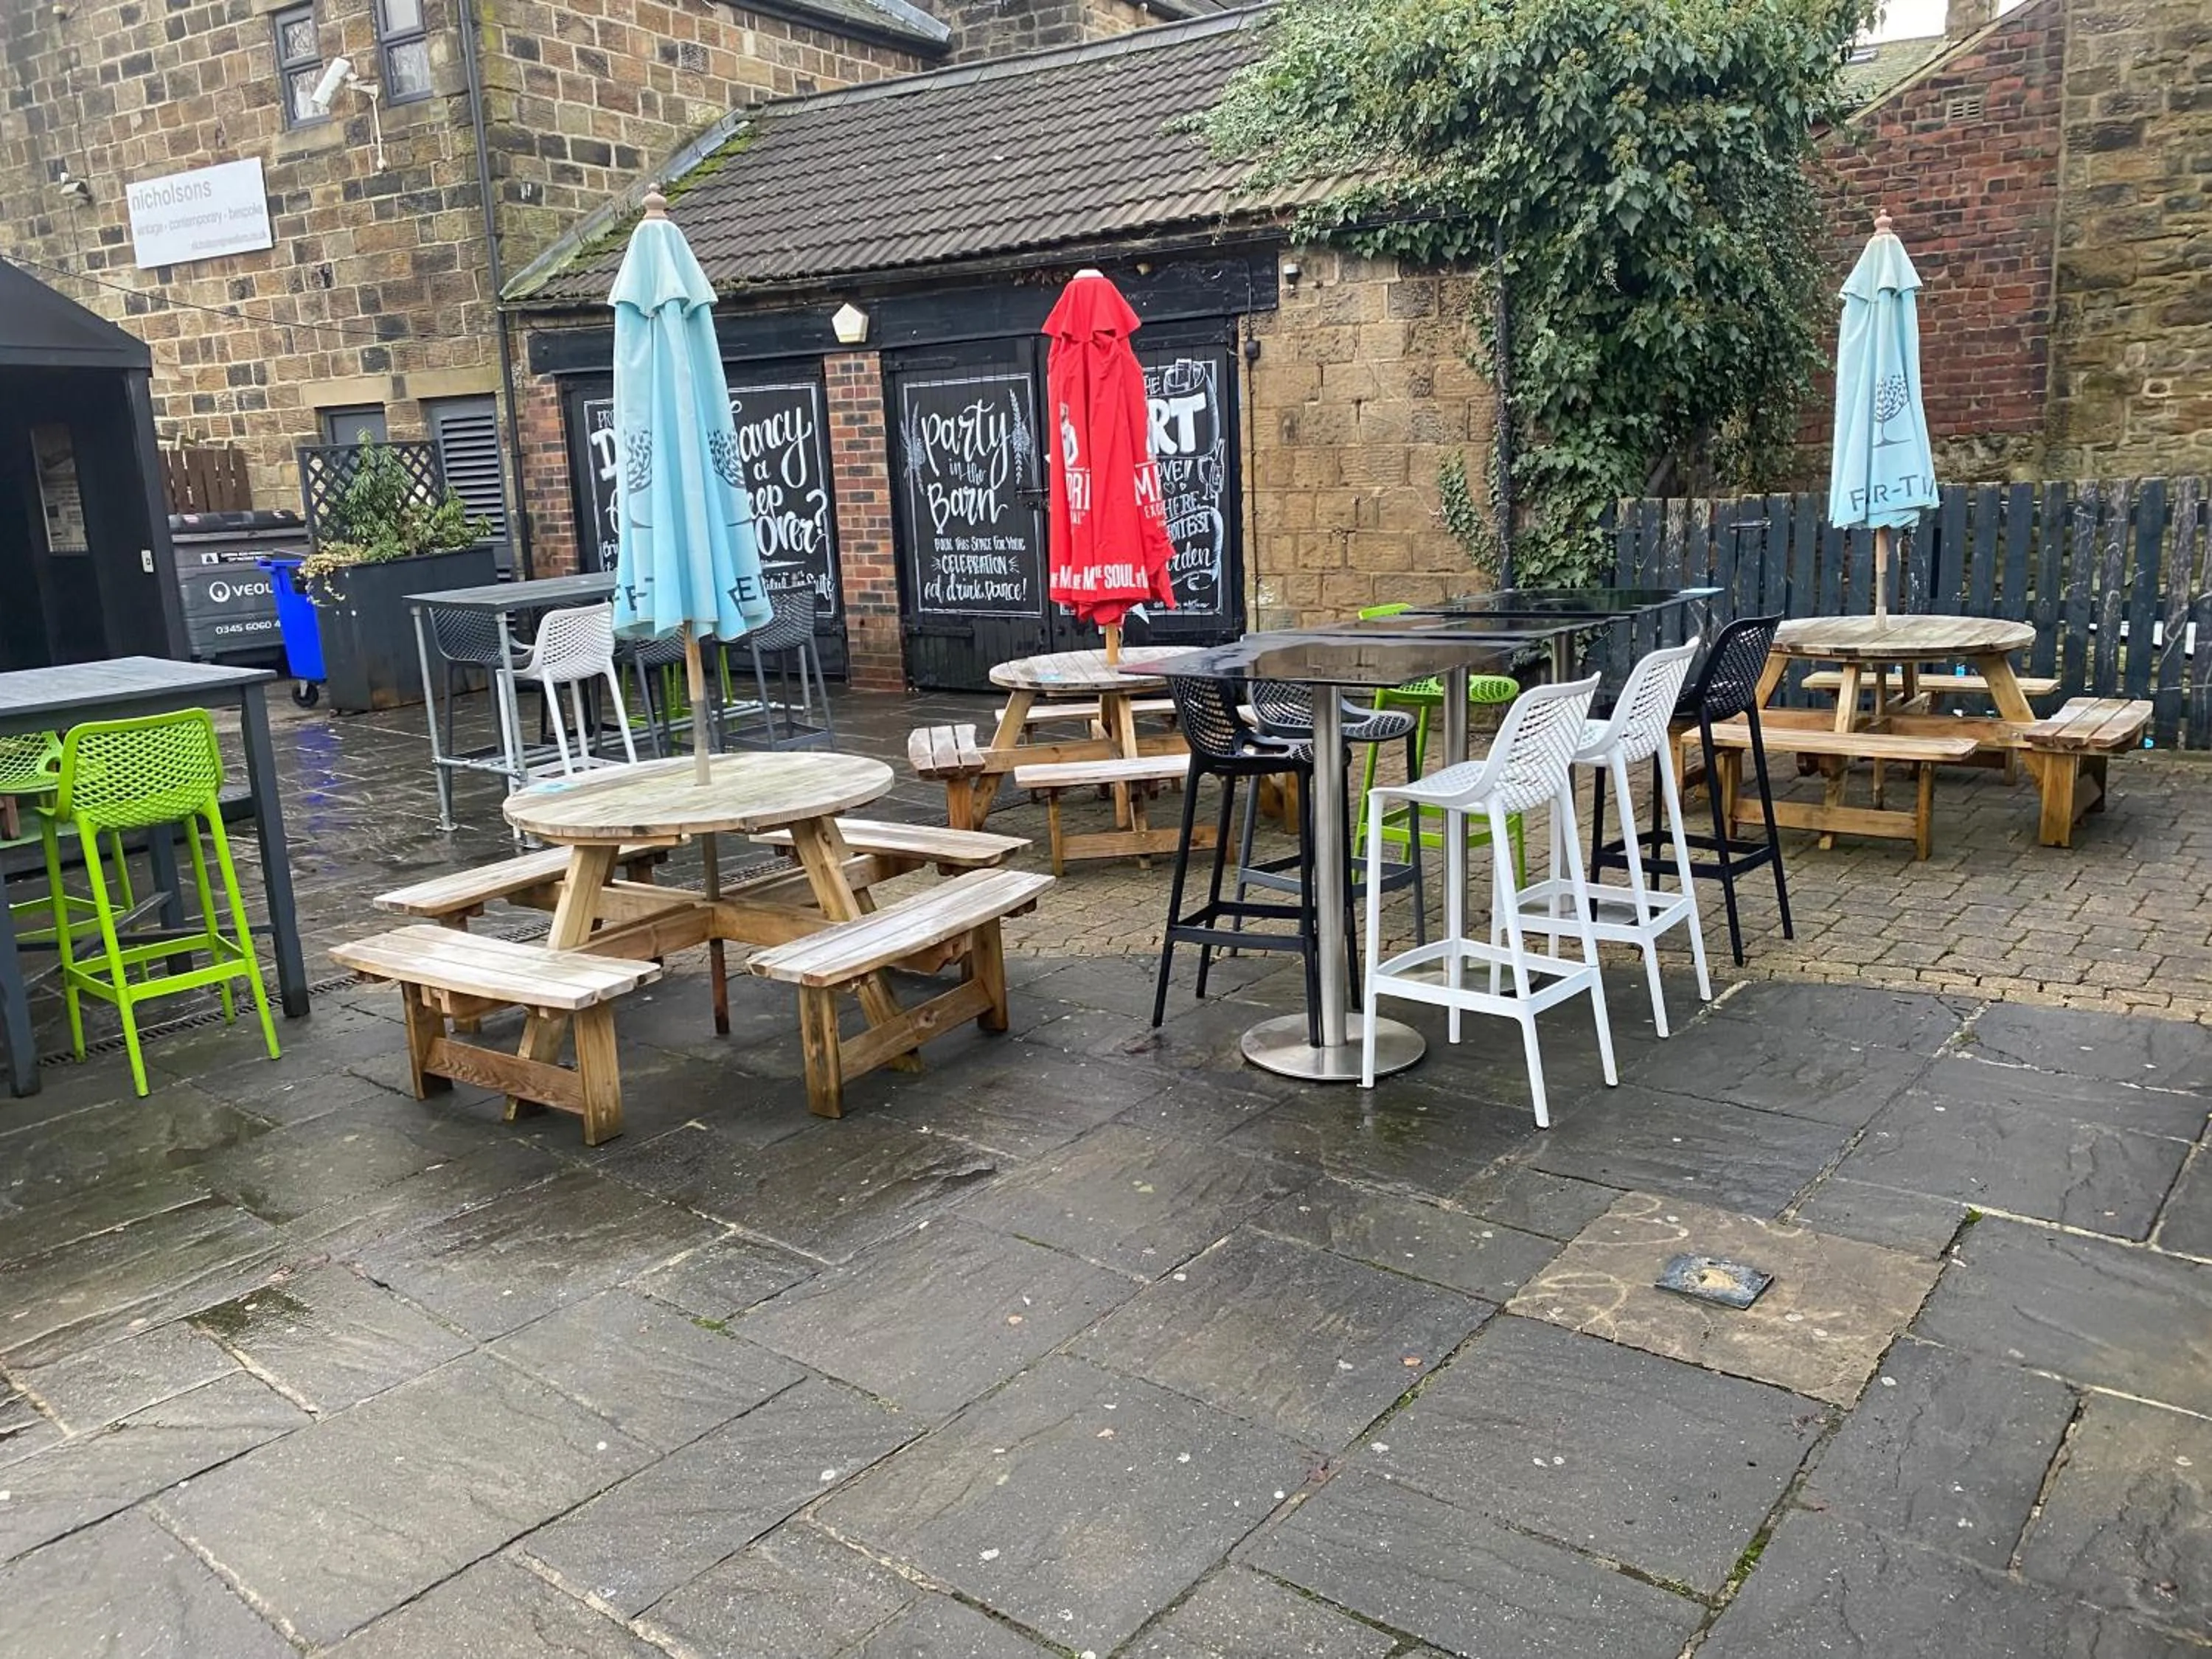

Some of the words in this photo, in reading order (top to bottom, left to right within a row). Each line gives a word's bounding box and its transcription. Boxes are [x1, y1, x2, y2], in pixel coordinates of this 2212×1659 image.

[132, 181, 212, 211] nicholsons
[170, 210, 221, 230] contemporary
[227, 202, 263, 220] bespoke
[739, 406, 812, 489] ancy
[753, 459, 771, 481] a
[948, 458, 963, 481] in
[747, 484, 784, 519] eep
[928, 482, 1008, 535] Barn
[941, 554, 1008, 575] CELEBRATION
[1104, 563, 1135, 588] SOUL
[232, 582, 274, 596] VEOL
[215, 624, 243, 635] 0345
[246, 621, 272, 631] 6060
